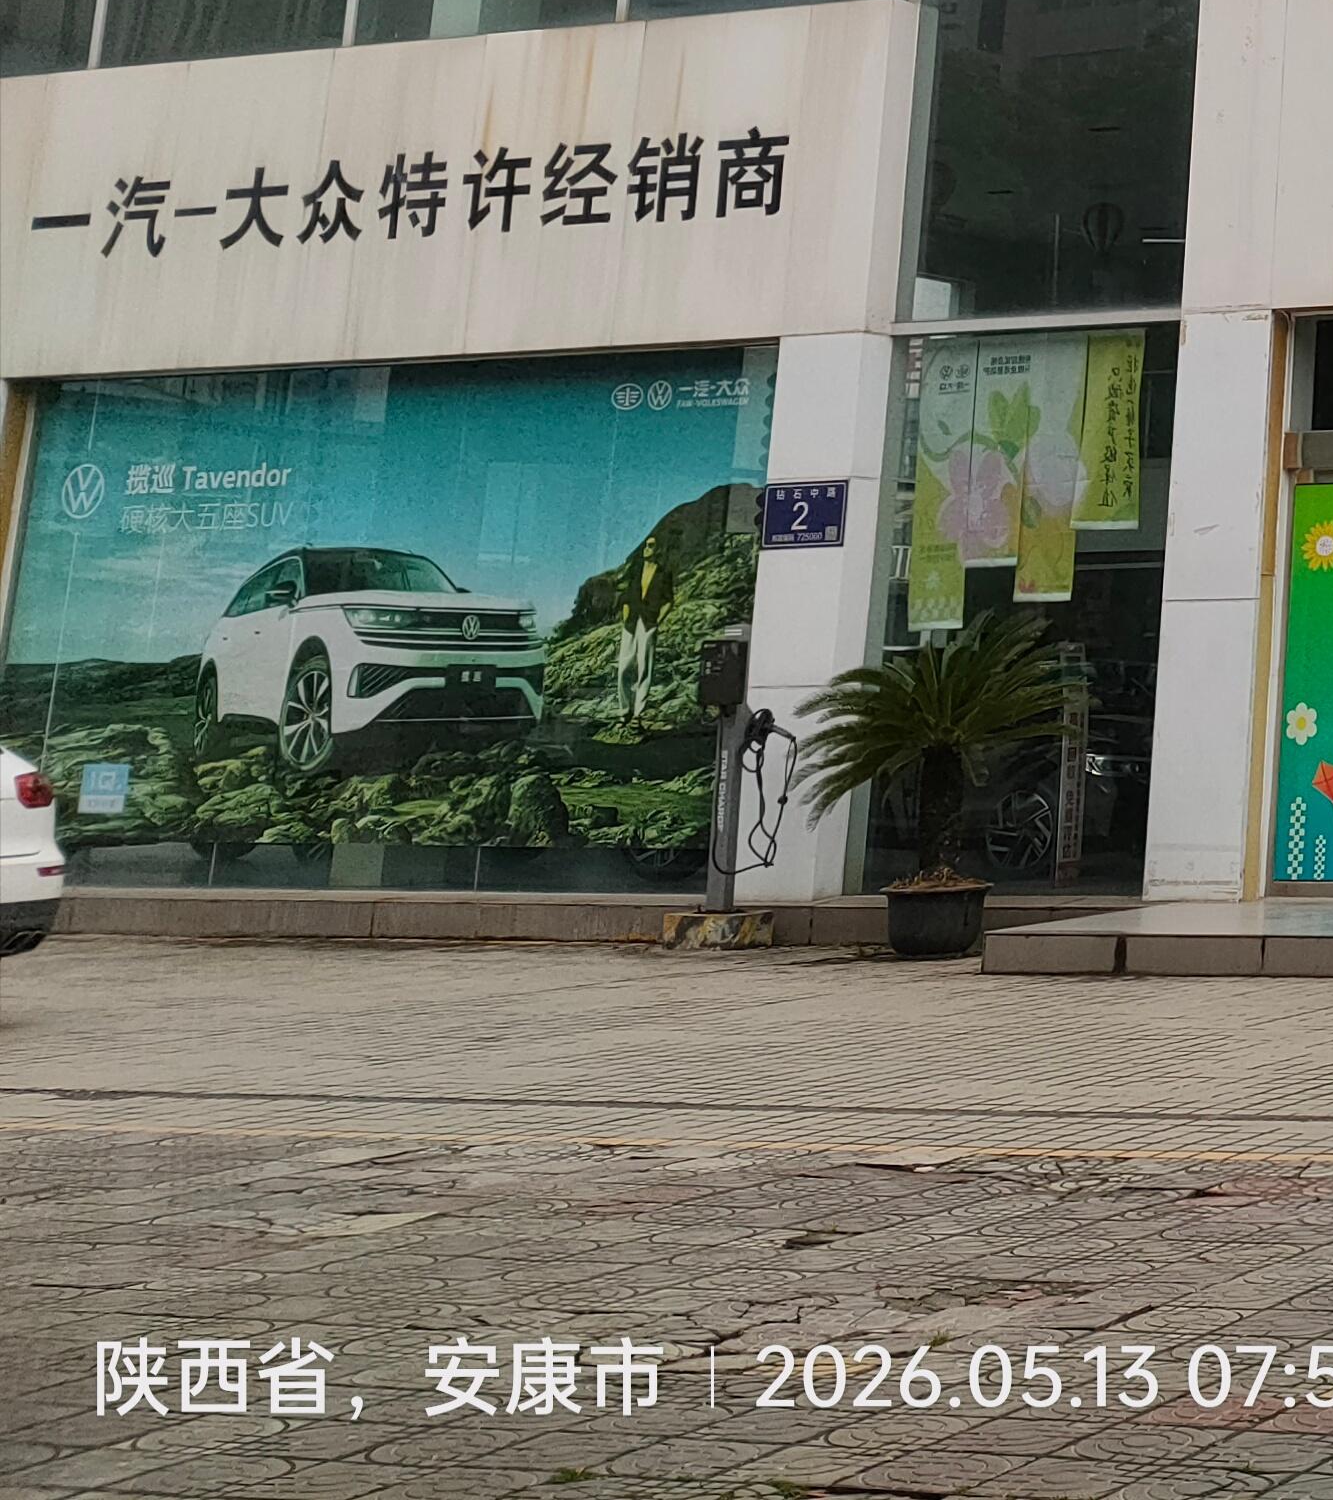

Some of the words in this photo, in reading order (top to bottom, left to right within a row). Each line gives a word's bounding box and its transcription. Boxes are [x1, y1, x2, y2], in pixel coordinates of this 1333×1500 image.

[31, 126, 791, 259] 一汽-大众特许经销商
[182, 461, 292, 489] Tavendor
[120, 499, 295, 534] 硬核大五座SUV
[790, 501, 809, 531] 2
